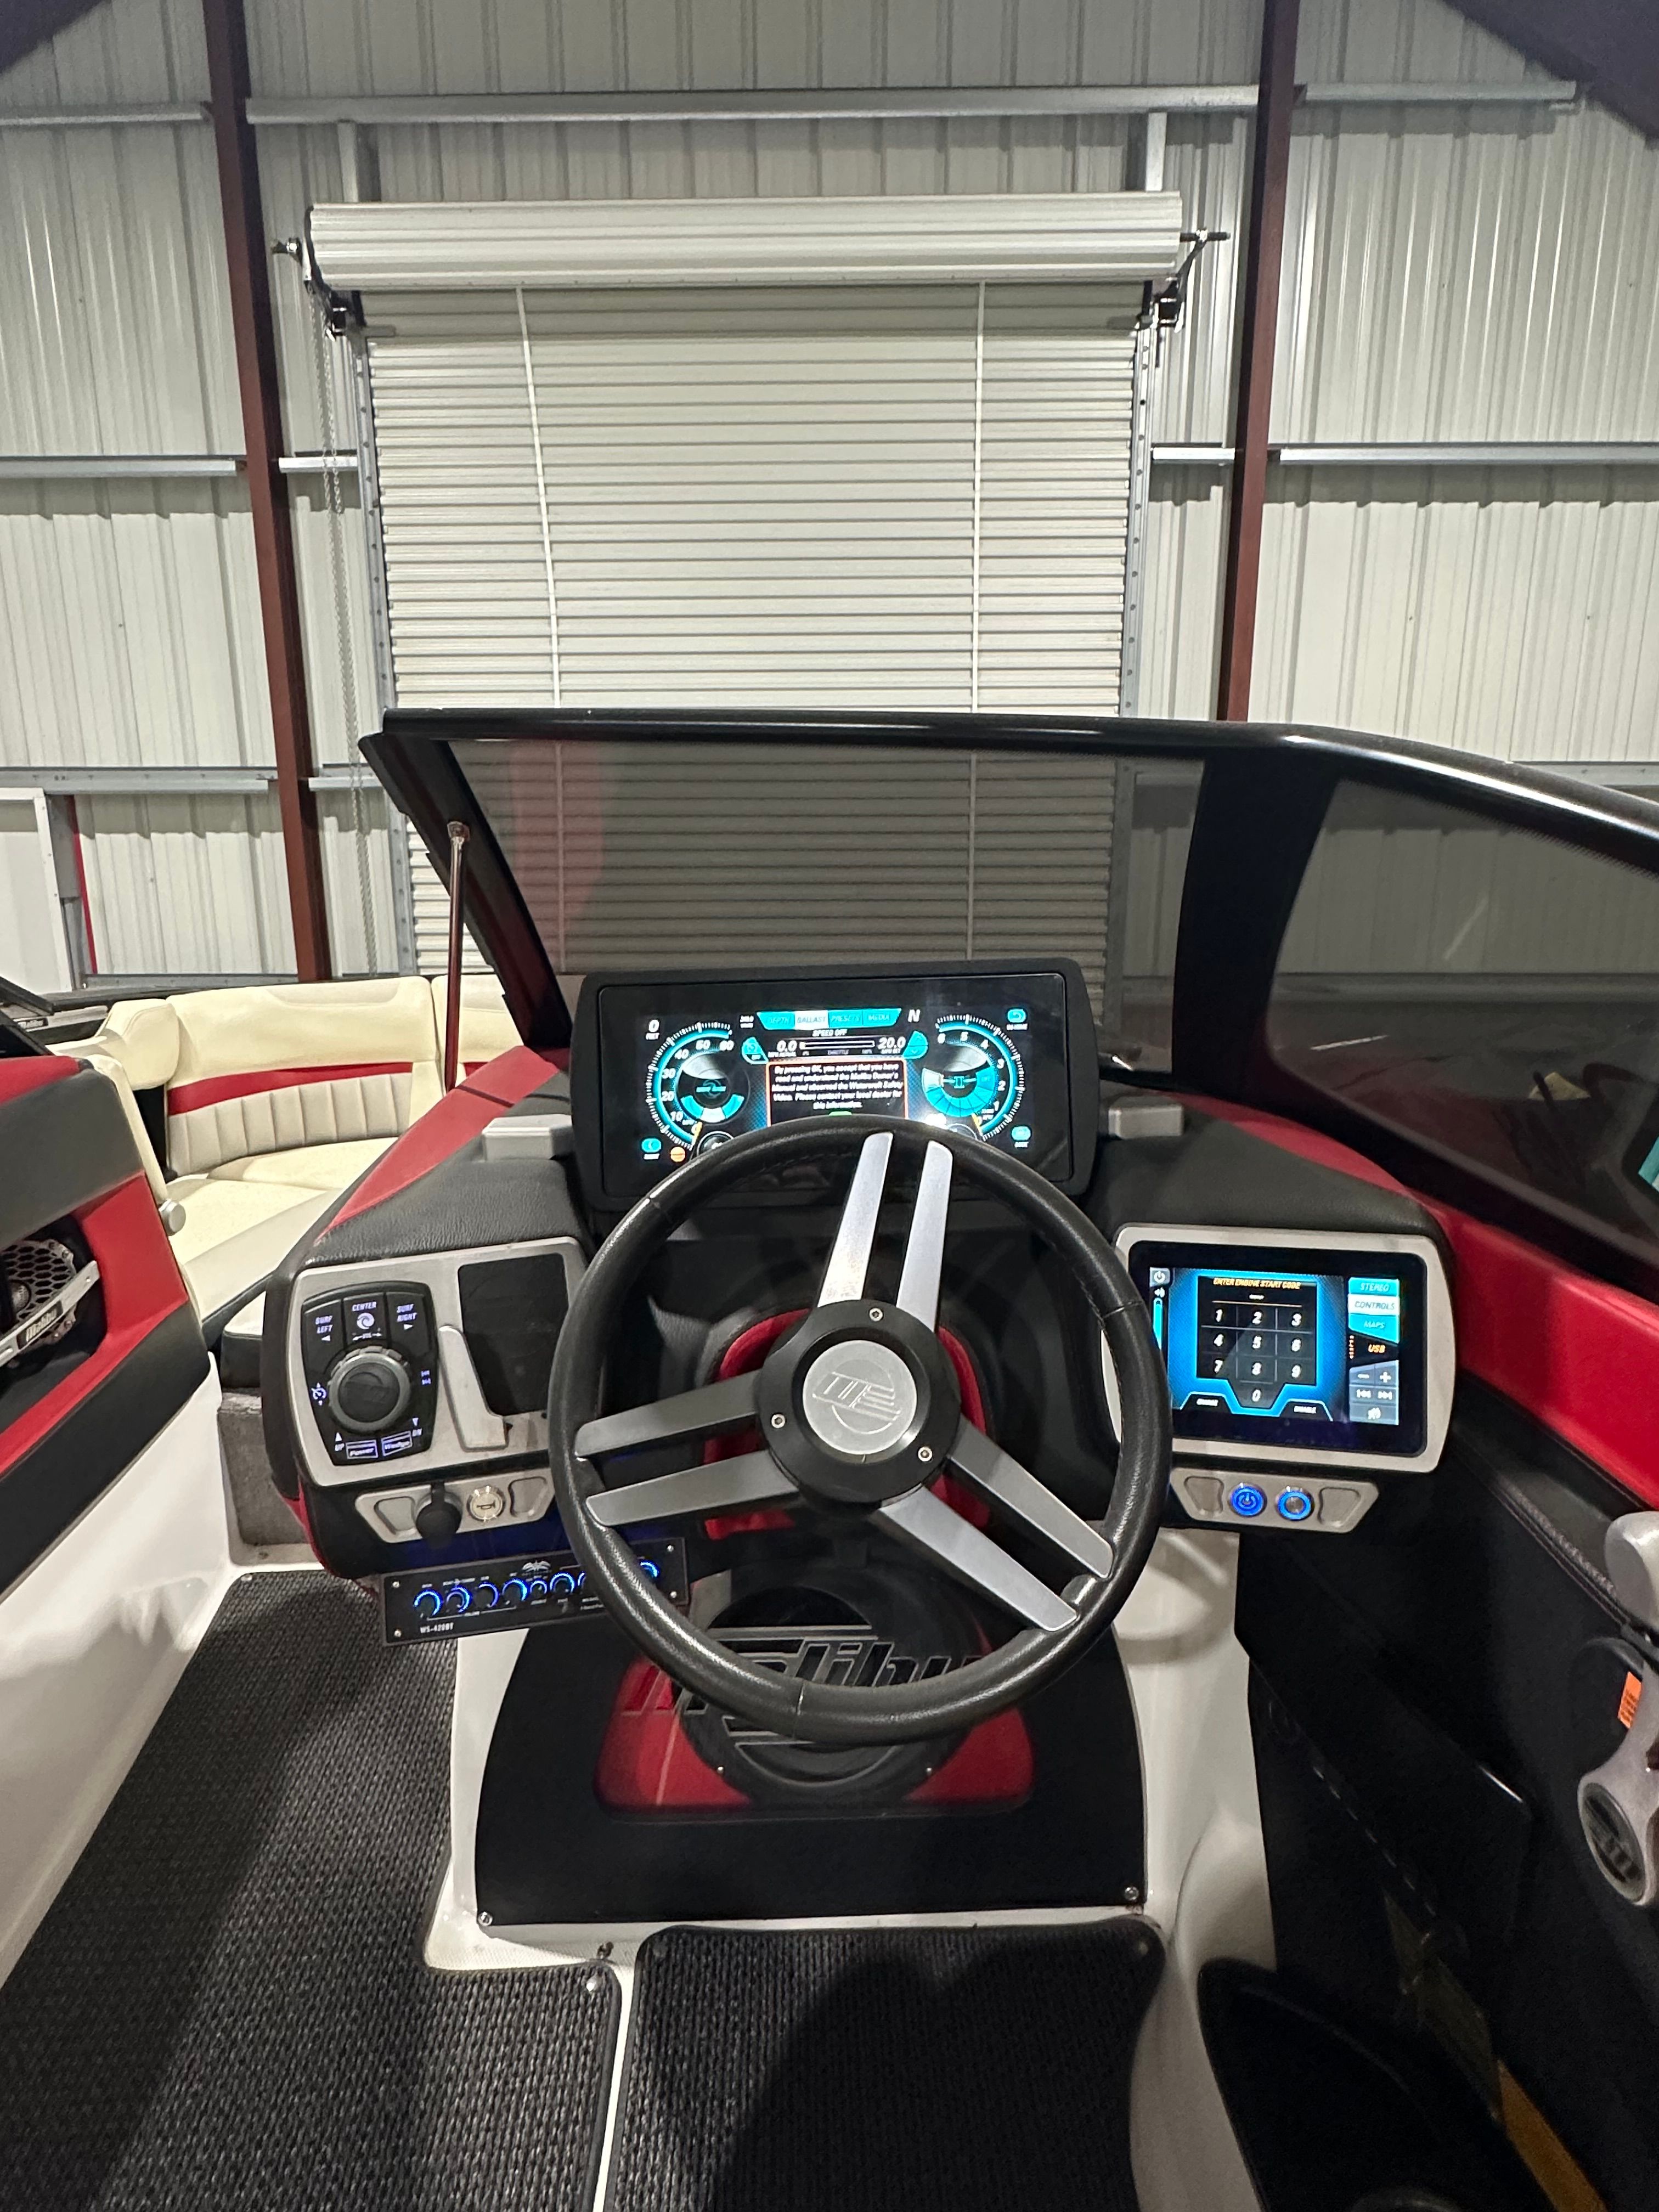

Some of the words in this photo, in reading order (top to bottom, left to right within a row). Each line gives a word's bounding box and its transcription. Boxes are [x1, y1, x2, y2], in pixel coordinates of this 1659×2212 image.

[908, 1009, 921, 1022] N
[648, 1019, 659, 1032] 0
[960, 1031, 969, 1041] 5
[695, 1040, 710, 1050] 50
[777, 1040, 797, 1052] 0.0
[878, 1037, 906, 1049] 20.0
[980, 1039, 989, 1049] 4
[674, 1048, 690, 1059] 40
[996, 1058, 1005, 1069] 3
[662, 1068, 676, 1079] 30
[997, 1081, 1006, 1091] 2
[662, 1091, 676, 1102] 20
[994, 1101, 1000, 1111] 1
[670, 1111, 684, 1121] 10
[1235, 1279, 1260, 1287] ENGINE
[1361, 1283, 1390, 1291] STEREO
[352, 1301, 377, 1311] CENTER
[1355, 1301, 1395, 1310] CONTROLS
[397, 1312, 417, 1322] RIGHT
[1216, 1309, 1222, 1322] 1
[1252, 1311, 1262, 1324] 2
[1291, 1313, 1302, 1326] 3
[317, 1324, 333, 1334] LEFT
[1363, 1321, 1385, 1329] MAPS
[1214, 1334, 1224, 1346] 4
[1252, 1336, 1262, 1348] 5
[1291, 1339, 1301, 1351] 6
[1368, 1344, 1386, 1353] USB
[1215, 1359, 1223, 1373] 7
[1252, 1363, 1262, 1375] 8
[1291, 1365, 1301, 1378] 9
[1252, 1389, 1261, 1402] 0
